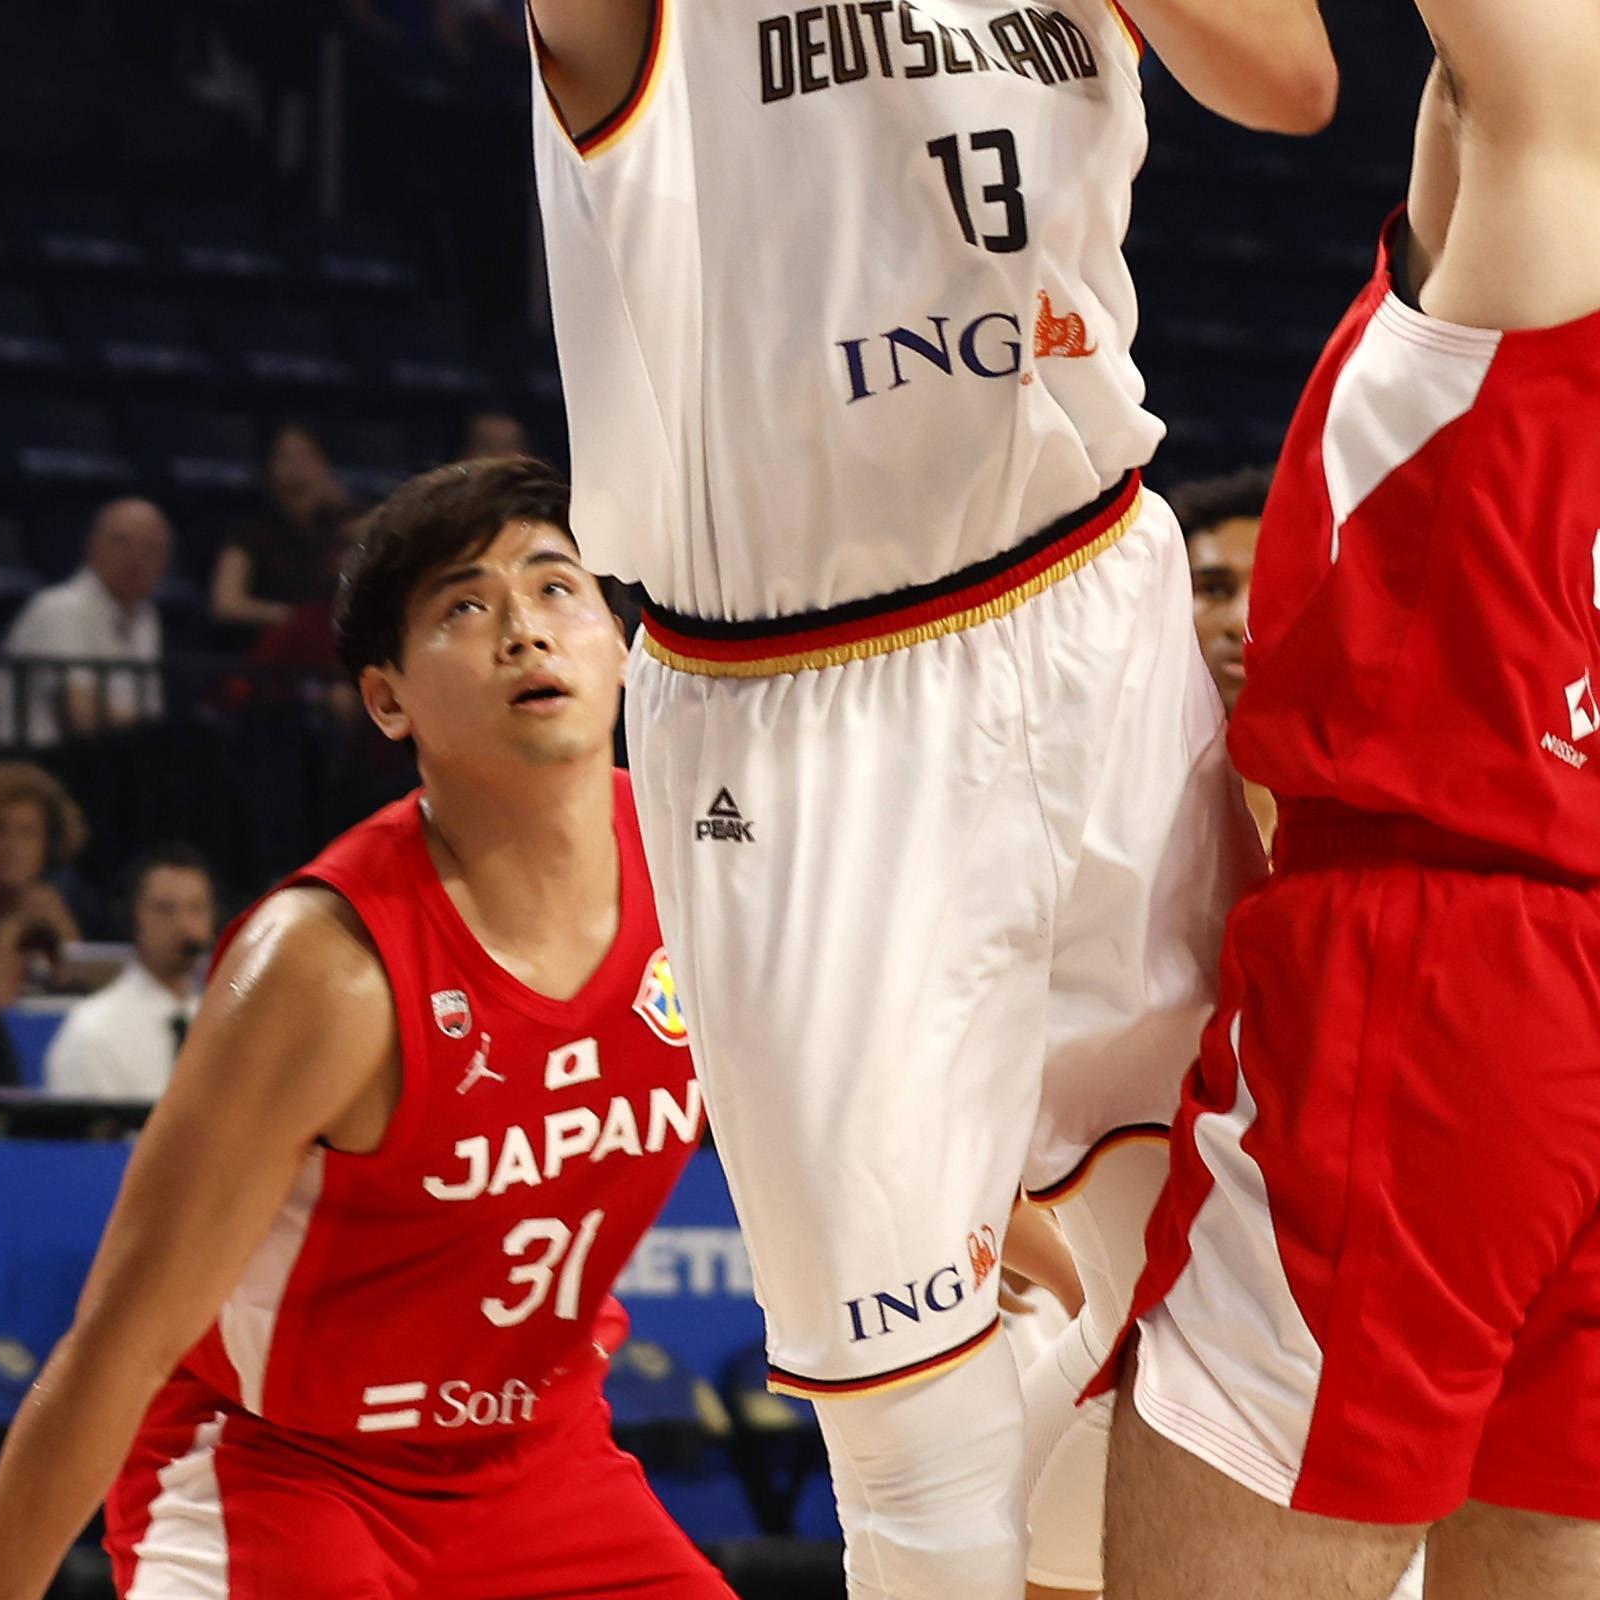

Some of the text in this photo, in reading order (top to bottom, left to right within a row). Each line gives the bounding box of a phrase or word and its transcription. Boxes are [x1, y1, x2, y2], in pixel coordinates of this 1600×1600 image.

[926, 128, 1028, 253] 13
[834, 311, 1022, 405] ING
[696, 819, 756, 842] PEAK
[422, 1080, 702, 1200] JAPAN
[481, 1209, 605, 1327] 31
[842, 1263, 964, 1343] ING
